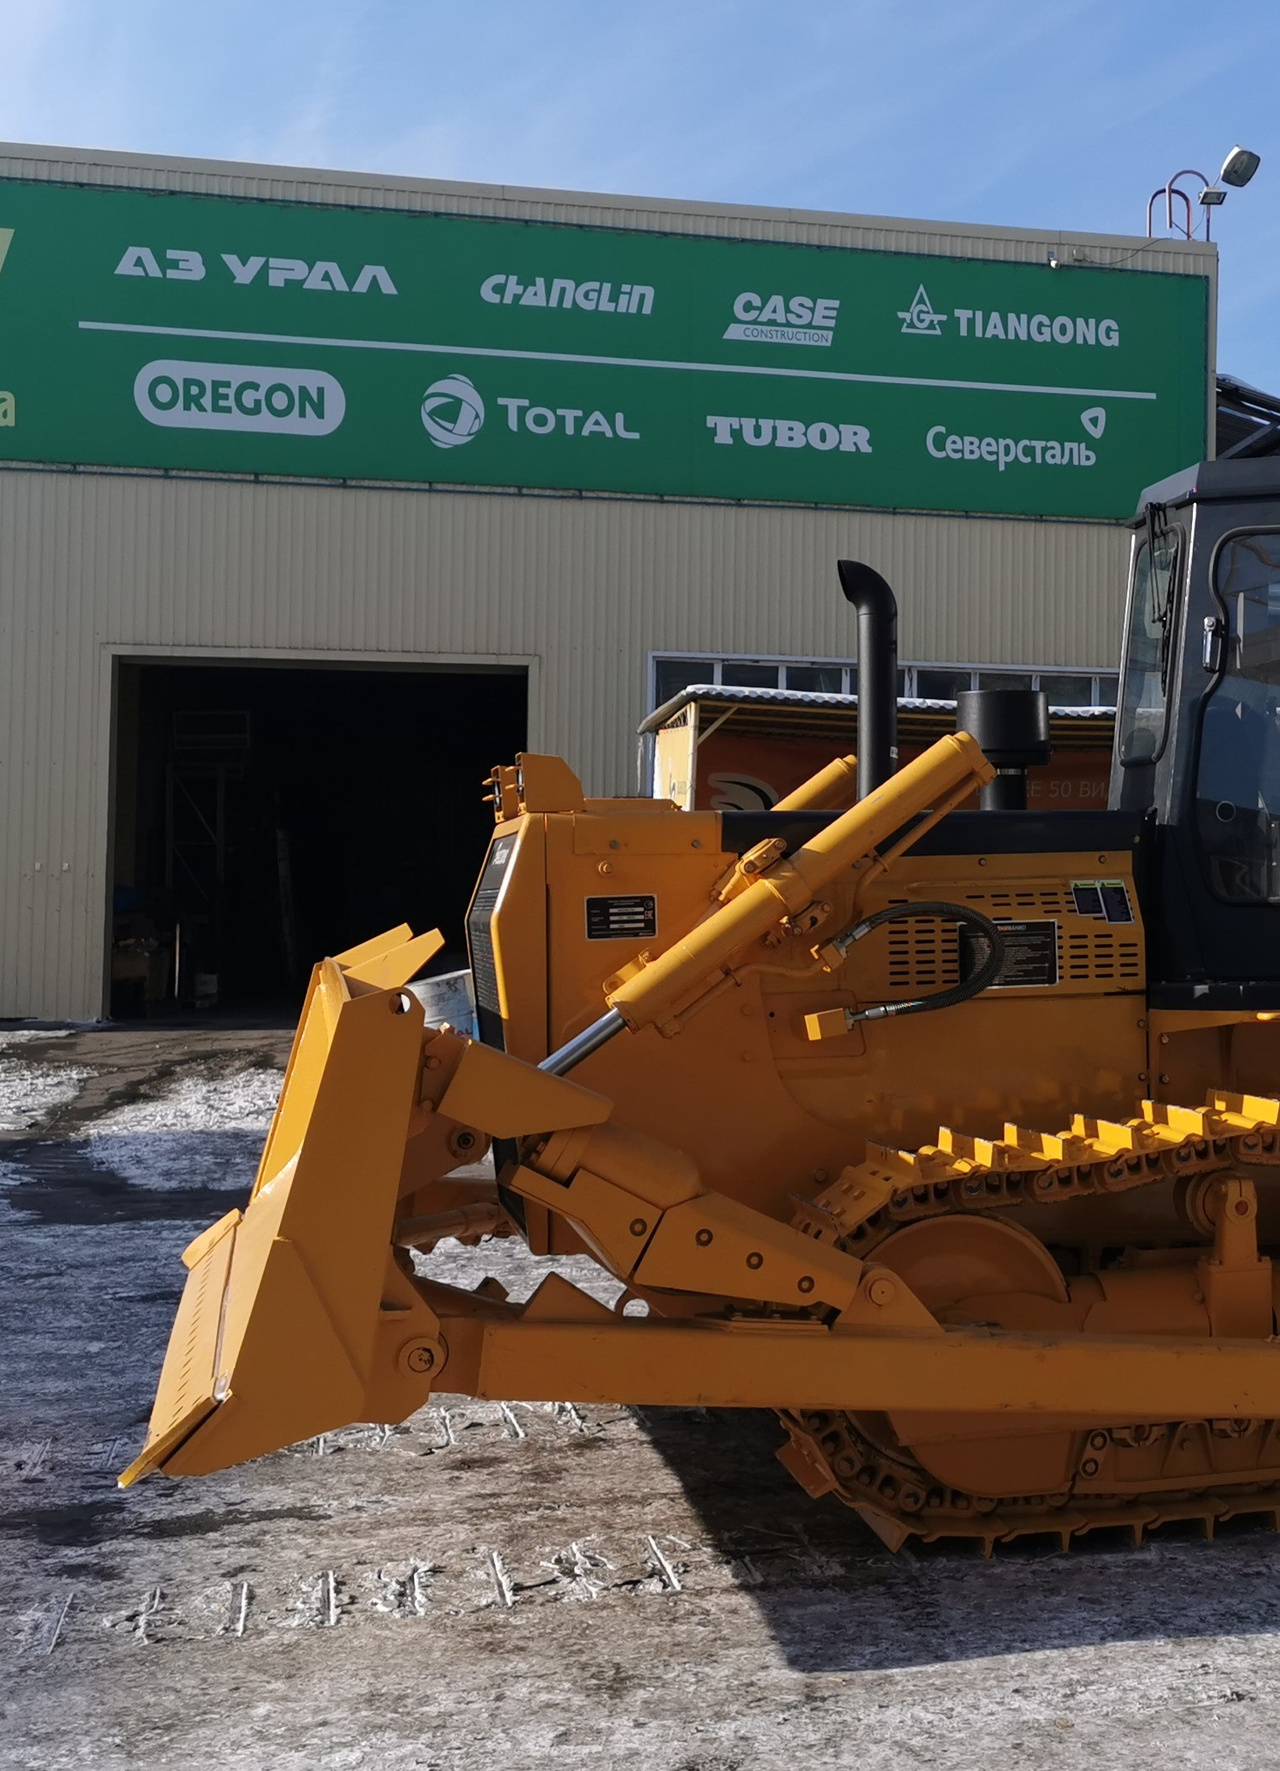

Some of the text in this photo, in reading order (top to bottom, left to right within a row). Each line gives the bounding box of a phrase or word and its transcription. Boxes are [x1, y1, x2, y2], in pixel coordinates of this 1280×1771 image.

[220, 253, 398, 295] УРАЛ
[733, 292, 840, 328] CASE
[954, 308, 1120, 347] TIANGONG
[743, 327, 829, 343] CONSTRUCTION
[147, 375, 326, 420] OREGON
[706, 415, 873, 453] TUBOR
[926, 425, 1096, 472] Северсталь
[1049, 781, 1072, 798] 50
[1078, 780, 1108, 799] ВИ
